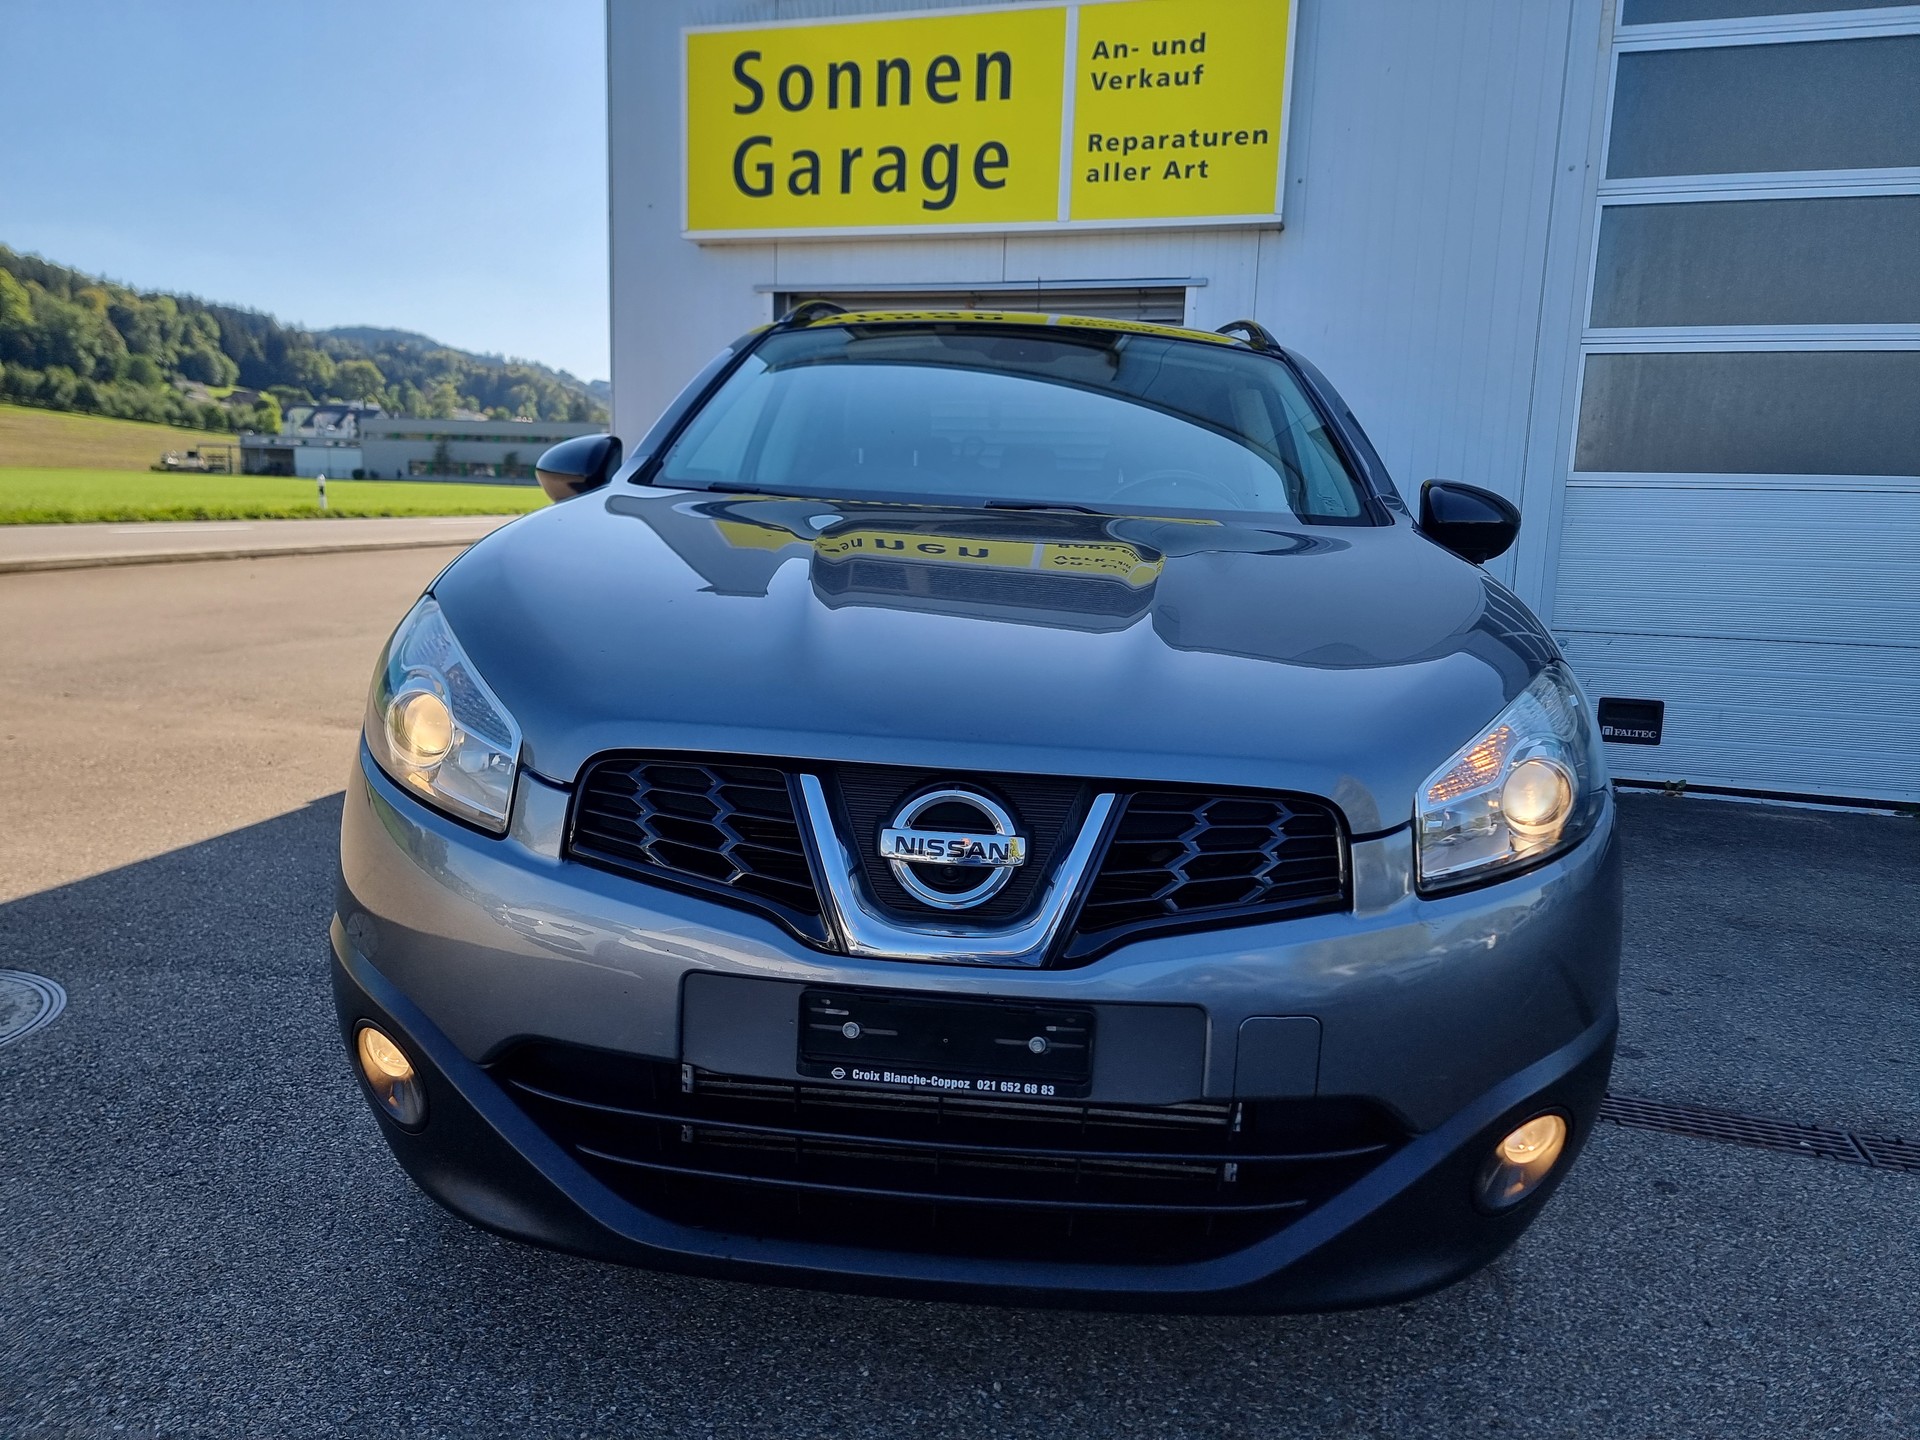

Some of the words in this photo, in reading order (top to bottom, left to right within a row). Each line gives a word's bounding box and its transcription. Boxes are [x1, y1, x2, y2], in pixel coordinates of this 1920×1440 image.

[1091, 40, 1140, 60] An-
[1151, 33, 1207, 57] und
[732, 48, 1012, 115] Sonnen
[1090, 65, 1205, 92] Verkauf
[1088, 127, 1270, 156] Reparaturen
[732, 135, 1010, 211] Garage
[1086, 161, 1151, 184] aller
[1162, 159, 1210, 181] Art
[1613, 728, 1657, 738] FALTEC
[895, 835, 1009, 860] NISSAN
[852, 1069, 880, 1082] Croix
[883, 1071, 970, 1090] Blanche-Coppoz
[977, 1079, 996, 1091] 021
[1000, 1081, 1021, 1093] 652
[1023, 1083, 1038, 1094] 68
[1041, 1084, 1055, 1096] 83
